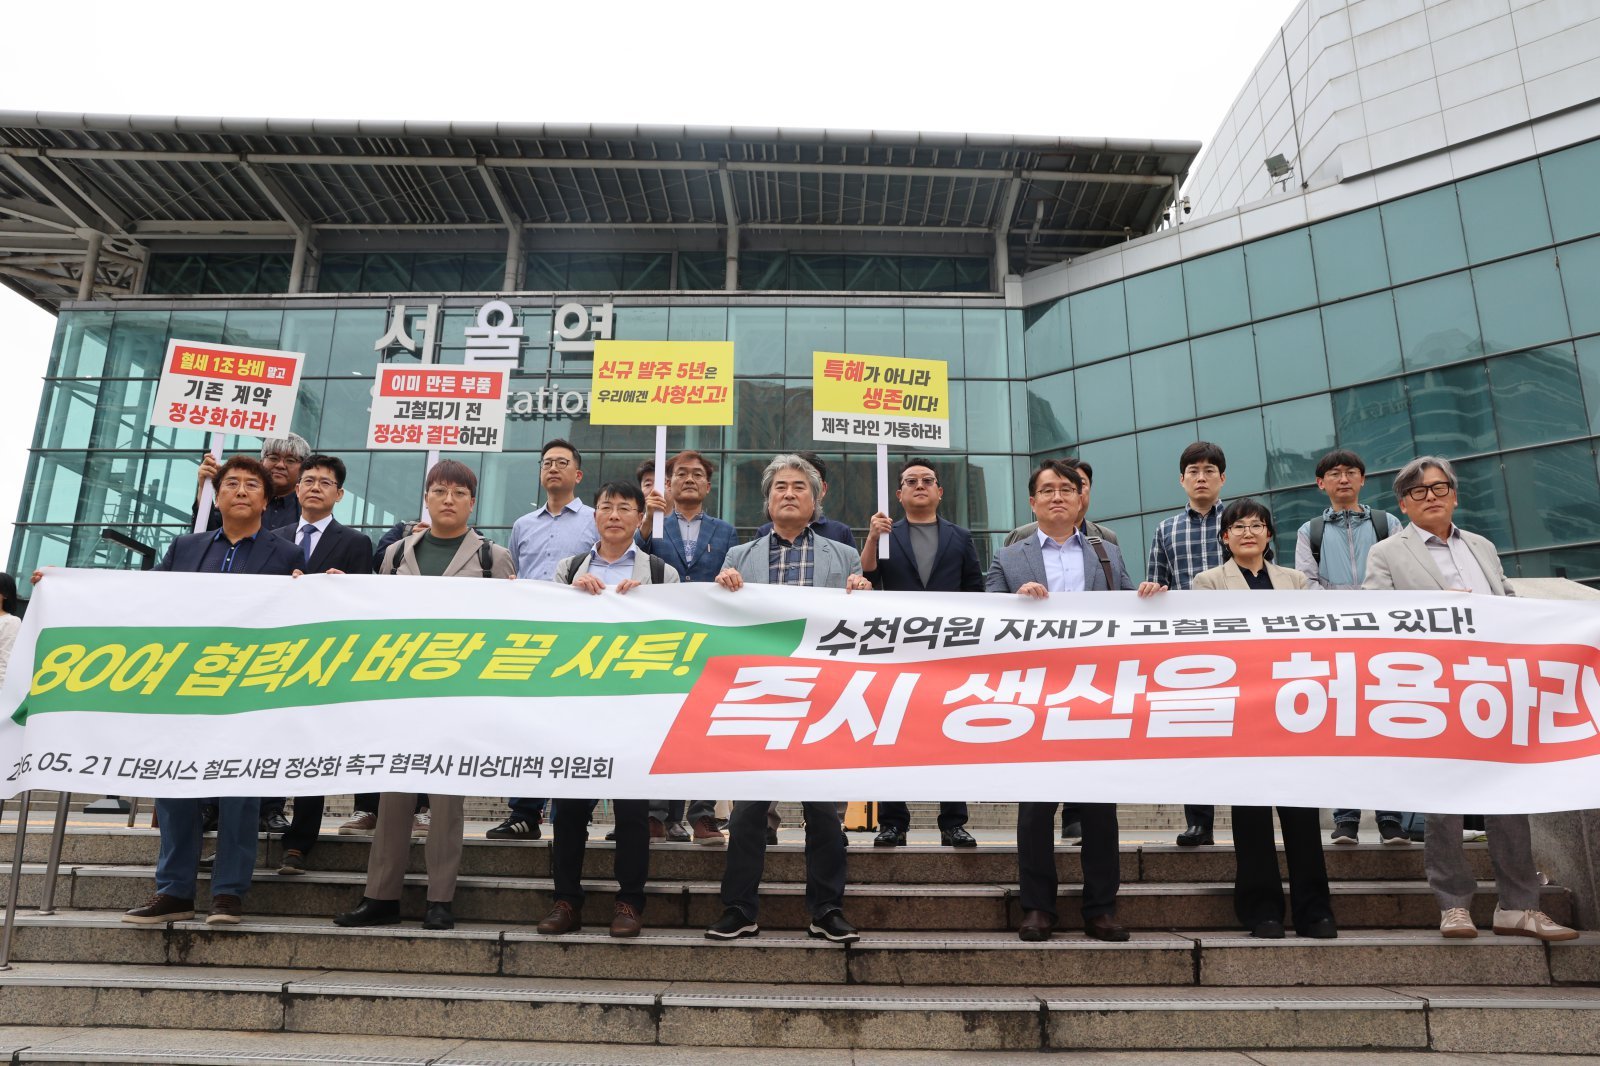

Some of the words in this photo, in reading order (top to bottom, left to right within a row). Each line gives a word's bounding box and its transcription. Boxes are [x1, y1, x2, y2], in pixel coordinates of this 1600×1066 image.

[180, 352, 209, 371] 혈세
[213, 357, 235, 374] 1조
[237, 359, 265, 377] 낭비
[267, 366, 286, 379] 말고
[598, 361, 634, 379] 신규
[638, 361, 673, 380] 발주
[676, 362, 718, 380] 5년은
[823, 359, 880, 382] 특혜가
[884, 367, 931, 386] 아니라
[184, 380, 223, 402] 기존
[232, 384, 272, 407] 계약
[391, 375, 420, 391] 이미
[426, 375, 456, 393] 만든
[461, 377, 491, 394] 부품
[597, 389, 648, 403] 우리에겐
[651, 385, 728, 404] 사형선고!
[394, 400, 460, 420] 고철되기
[466, 402, 482, 421] 전
[863, 387, 939, 412] 생존이다!
[169, 402, 276, 431] 정상화하라!
[821, 417, 849, 434] 제작
[853, 419, 880, 436] 라인
[884, 421, 942, 440] 가동하라!
[374, 424, 423, 444] 정상화
[427, 425, 498, 446] 결단하라!
[815, 616, 985, 656] 수천억원
[993, 618, 1120, 642] 자재가
[1130, 618, 1251, 636] 고철로
[1261, 613, 1380, 633] 변하고
[1388, 607, 1476, 635] 있다!
[30, 642, 190, 695] 80여
[176, 634, 360, 697] 협력사
[351, 632, 486, 681] 벼랑
[478, 633, 559, 680] 끝
[550, 632, 708, 679] 사투!
[706, 666, 921, 750] 즉시
[942, 654, 1241, 744] 생산을
[37, 752, 73, 773] 05.
[79, 755, 112, 775] 21
[117, 757, 199, 780] 다원시스
[202, 758, 282, 780] 철도사업
[284, 755, 342, 779] 정상화
[345, 753, 386, 776] 촉구
[389, 753, 454, 776] 협력사
[457, 755, 544, 779] 비상대책
[548, 756, 614, 779] 위원회
